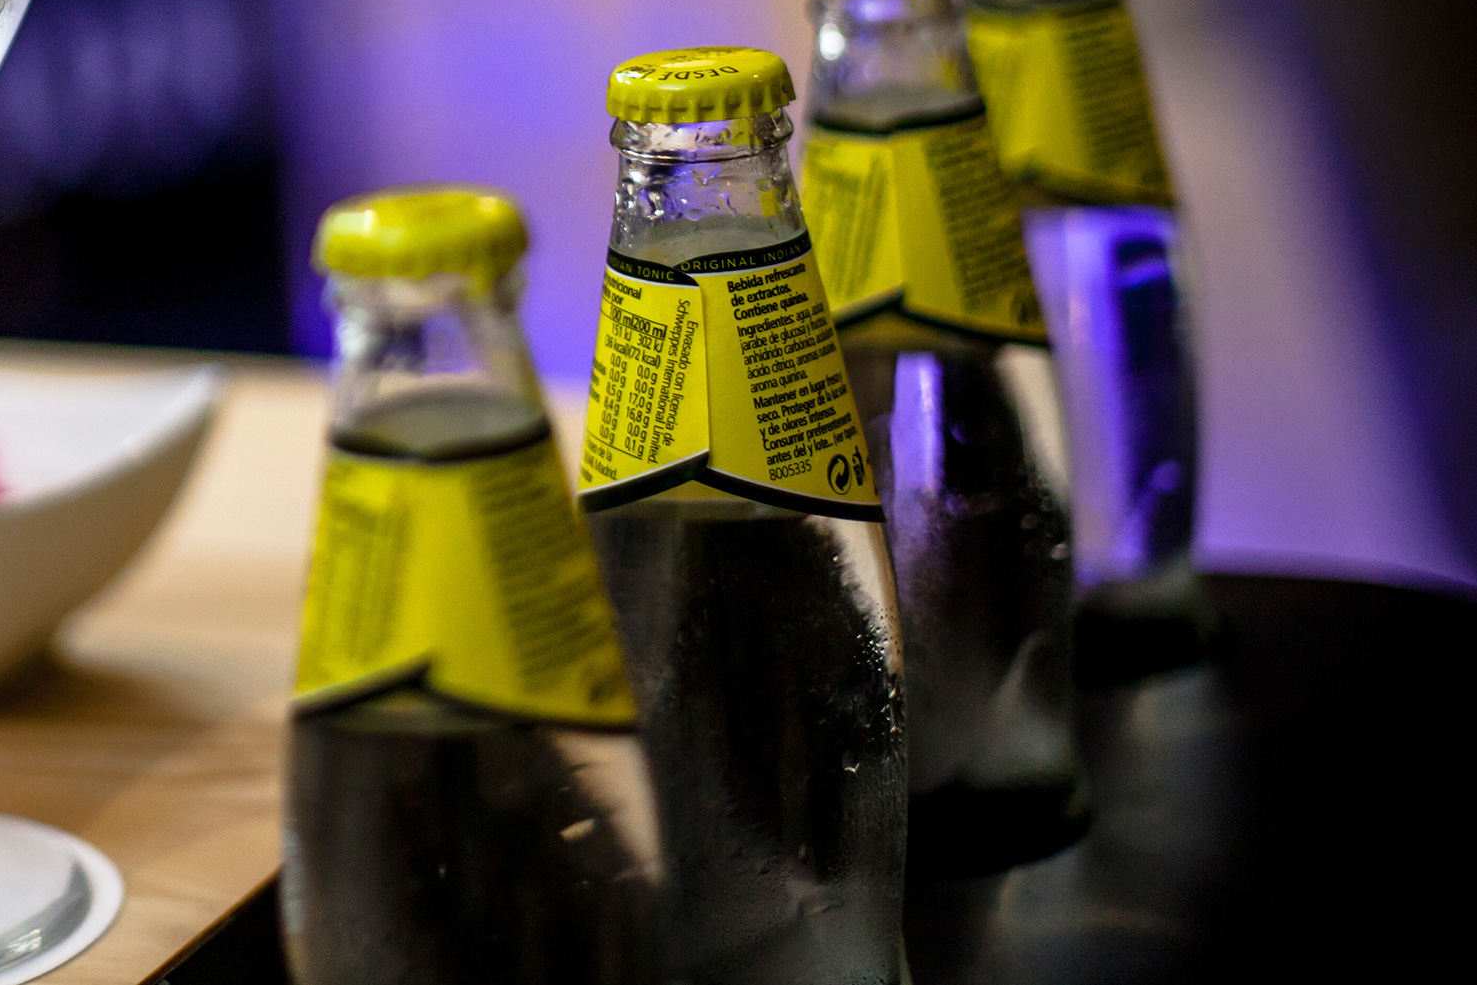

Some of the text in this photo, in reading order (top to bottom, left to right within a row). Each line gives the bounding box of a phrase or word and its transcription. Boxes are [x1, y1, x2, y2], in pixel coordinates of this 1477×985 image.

[658, 66, 739, 80] DESDE
[680, 245, 800, 271] ORIGINAL INDIAN
[637, 266, 674, 281] TONIC
[727, 262, 806, 293] Bebida refrescante
[612, 292, 624, 306] por
[731, 294, 745, 307] de
[733, 302, 778, 320] Contiene
[612, 322, 623, 338] 151
[632, 315, 651, 333] 200
[668, 298, 690, 357] Schweppes
[737, 314, 794, 338] Ingredientes:
[636, 334, 652, 350] 302
[740, 336, 768, 356] jarabe
[768, 330, 780, 344] de
[780, 324, 806, 344] glucosa
[642, 350, 662, 370] kcal)
[746, 363, 770, 380] ácido
[796, 350, 819, 366] aromas
[650, 372, 658, 386] g
[662, 320, 699, 446] Envasado con licencia de
[750, 378, 778, 394] aroma
[648, 386, 655, 400] g
[655, 358, 678, 425] International
[753, 389, 797, 410] Mantener
[798, 386, 810, 397] en
[809, 379, 826, 396] lugar
[645, 401, 652, 414] g
[756, 410, 781, 424] seco.
[781, 398, 816, 417] Proteger
[817, 392, 826, 406] de
[642, 416, 650, 429] g
[759, 427, 766, 442] y
[768, 422, 780, 436] de
[782, 415, 808, 432] olores
[640, 430, 647, 444] g
[762, 429, 805, 452] Consumir
[637, 444, 644, 458] g
[766, 449, 792, 466] antes
[793, 443, 807, 458] del
[768, 458, 812, 481] 8005335
